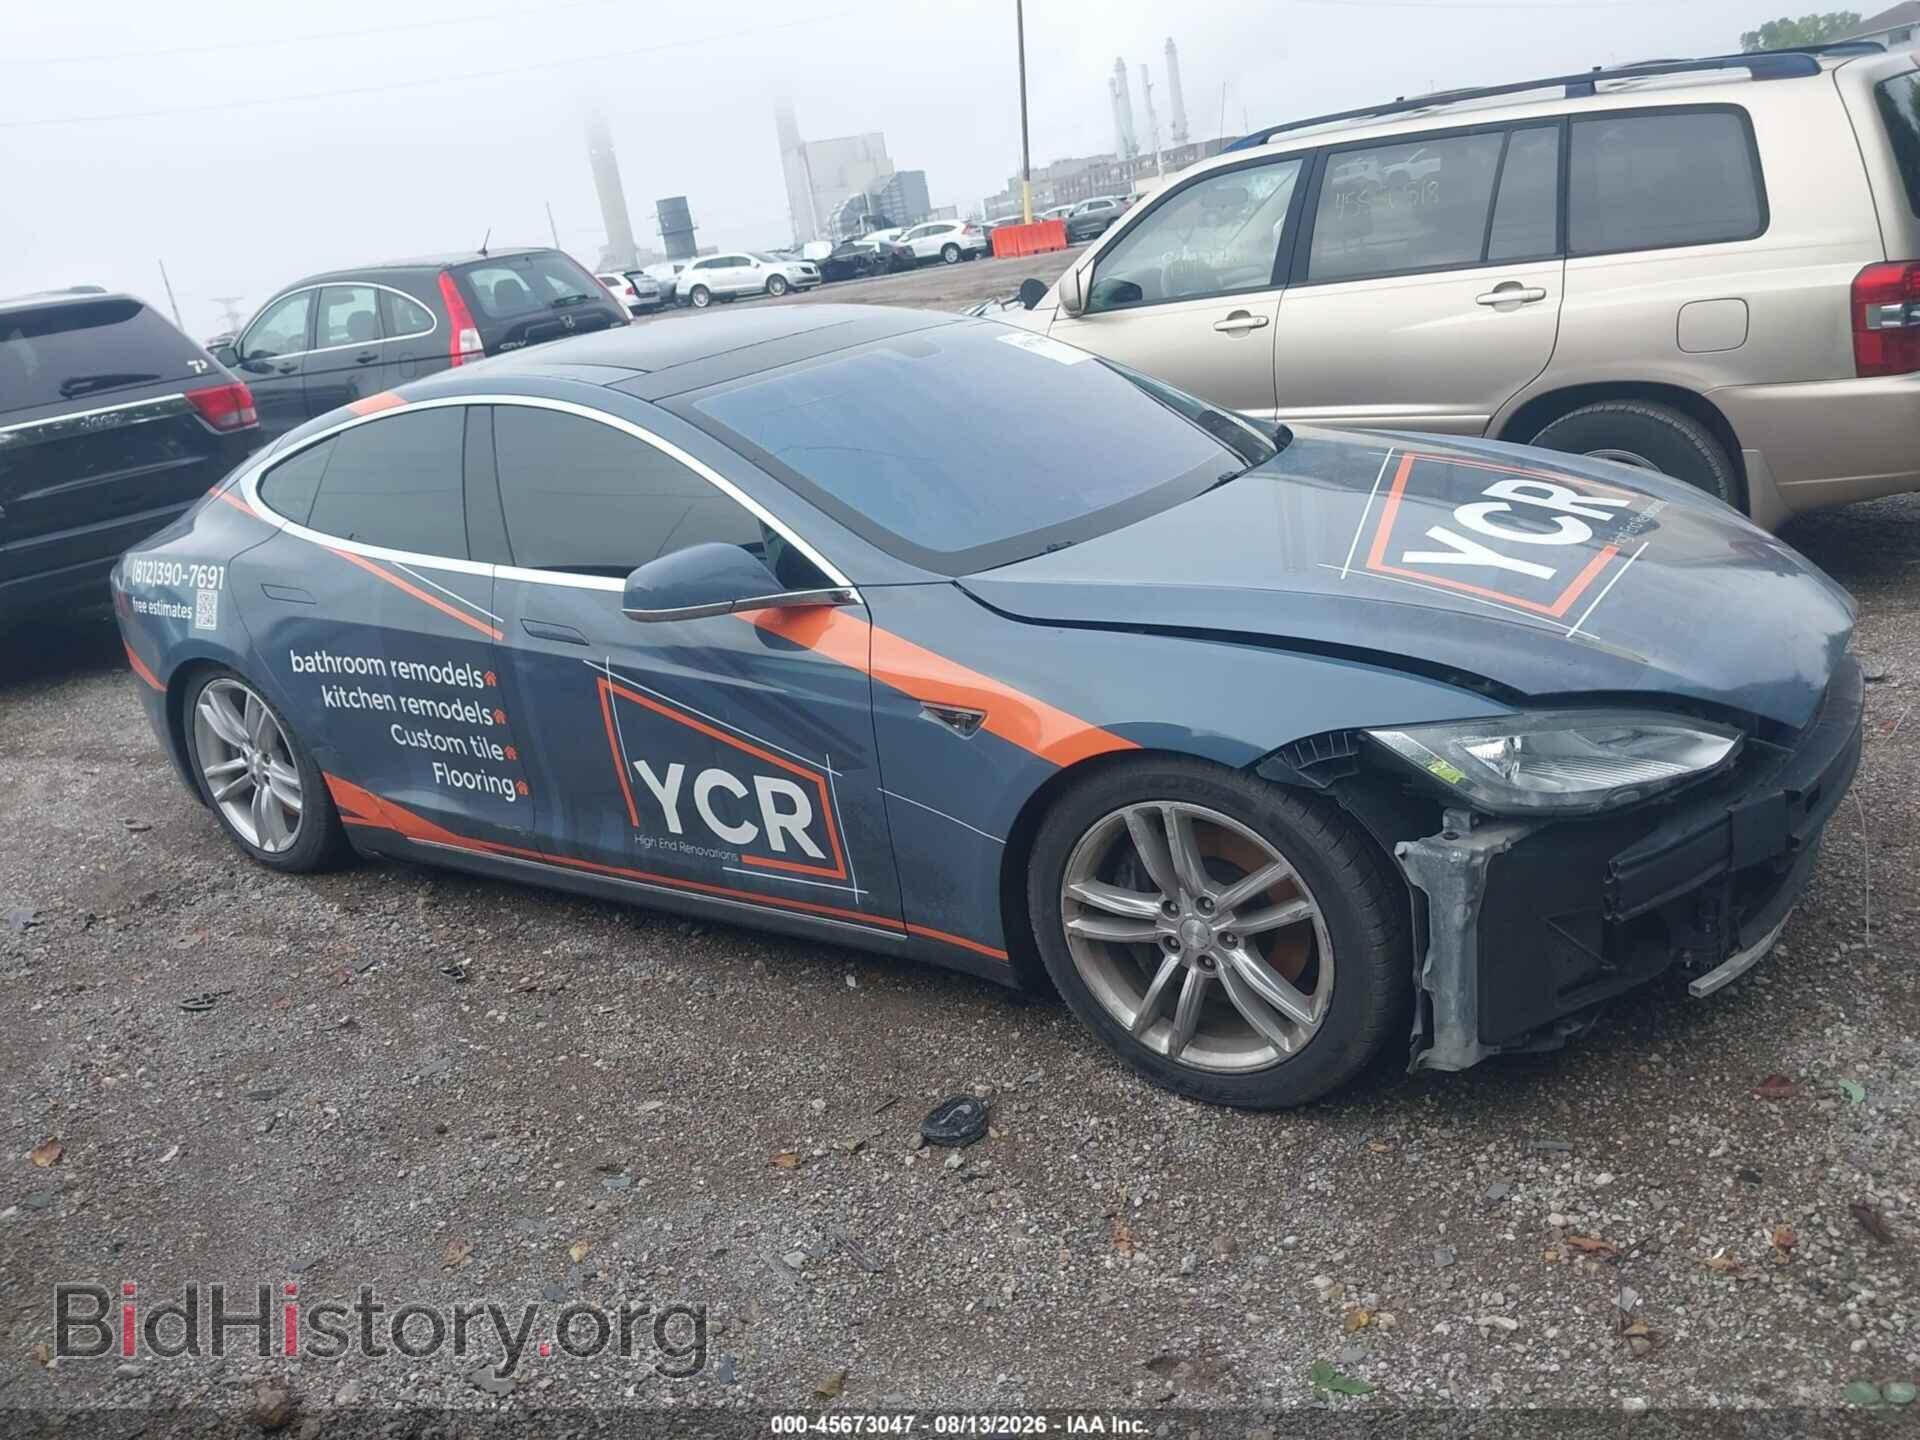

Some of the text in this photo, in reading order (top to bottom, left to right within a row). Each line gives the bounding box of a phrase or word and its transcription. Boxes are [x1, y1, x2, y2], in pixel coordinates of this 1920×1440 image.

[1401, 478, 1632, 581] YCR
[131, 558, 225, 590] (812)390-7691
[132, 596, 193, 619] free estimates
[290, 650, 484, 688] bathroom remodels
[321, 685, 493, 726] kitchen remodels
[390, 723, 505, 761] Custom tile
[432, 761, 516, 802] Flooring
[633, 759, 827, 860] YCR
[634, 833, 739, 862] High End Renovations
